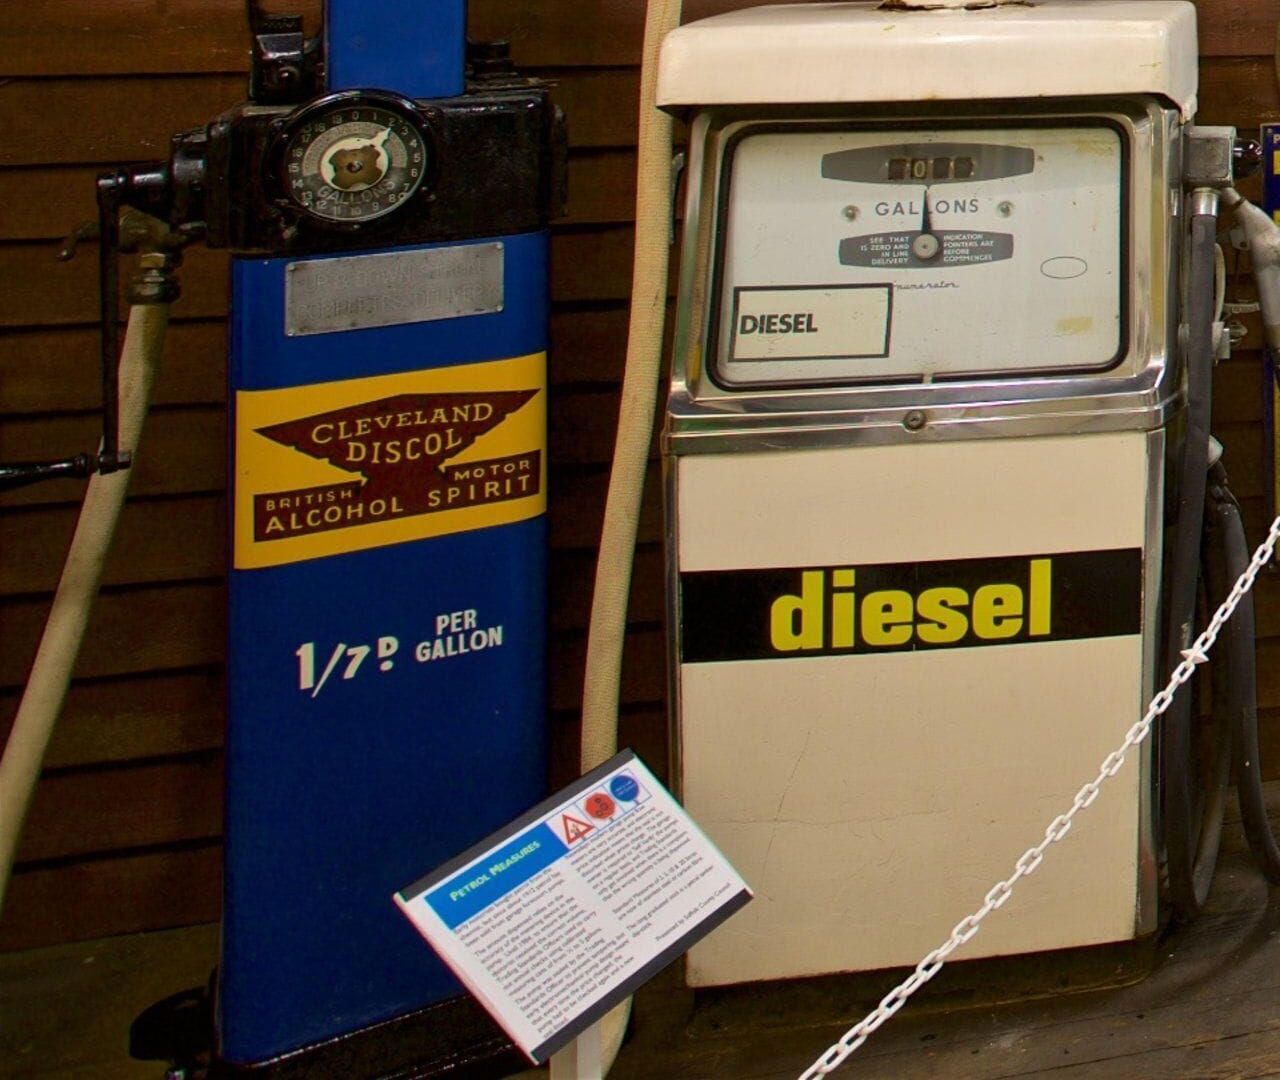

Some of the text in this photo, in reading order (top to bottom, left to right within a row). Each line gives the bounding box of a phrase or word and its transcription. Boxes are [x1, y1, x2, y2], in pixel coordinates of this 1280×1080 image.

[317, 180, 396, 205] GALLONS
[943, 254, 993, 262] COMMENCES
[740, 314, 817, 335] DIESEL
[312, 402, 493, 444] CLEVELAND
[346, 428, 463, 463] DISCOL
[265, 474, 530, 534] ALCOHOL SPIRIT
[266, 460, 530, 512] BRITISH MOTOR
[436, 608, 477, 635] PER
[770, 559, 1052, 652] diesel
[415, 626, 503, 662] GALLON
[449, 840, 541, 902] PETROL MEASURES
